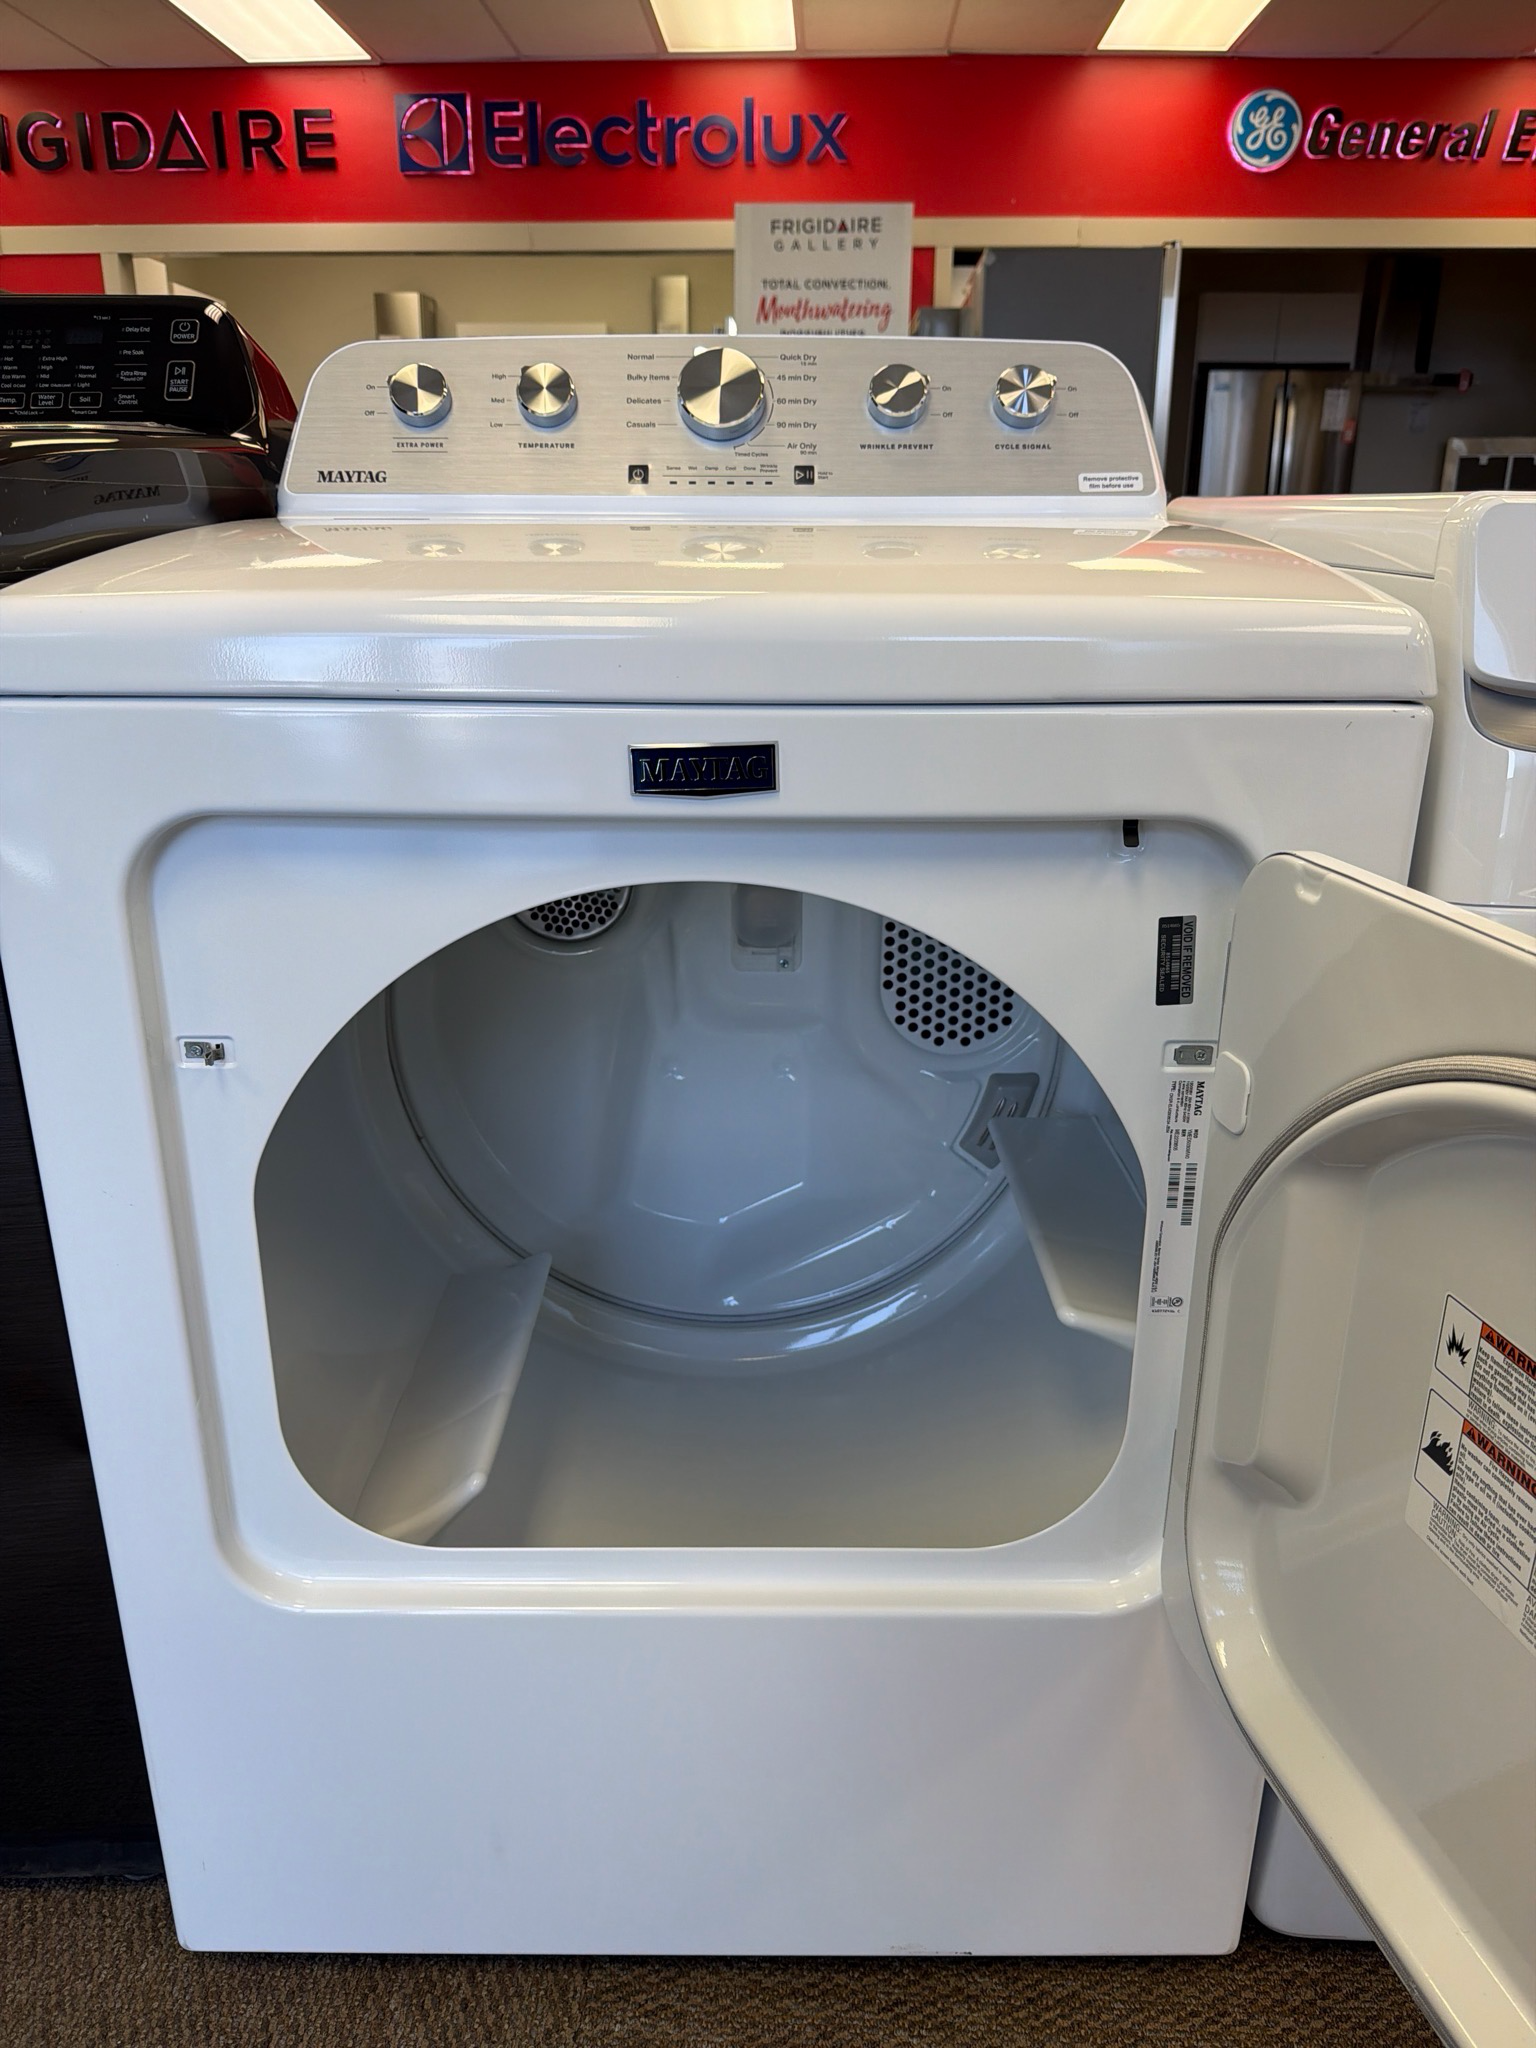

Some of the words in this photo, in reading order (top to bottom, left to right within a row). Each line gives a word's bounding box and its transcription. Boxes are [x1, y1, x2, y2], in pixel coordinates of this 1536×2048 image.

[482, 97, 849, 168] Electrolux
[1305, 105, 1500, 161] General
[770, 216, 883, 235] FRIGIDAIRE
[773, 238, 879, 252] GALLERY
[761, 279, 800, 291] TOTAL
[756, 294, 893, 333] Mouthwatering
[627, 353, 655, 361] Normal
[803, 354, 817, 362] Dry
[492, 373, 507, 381] High
[627, 374, 647, 382] Bulky
[803, 374, 817, 382] Dry
[803, 398, 817, 406] Dry
[803, 422, 817, 430] Dry
[800, 443, 817, 451] Only
[317, 470, 387, 484] MAYTAG
[639, 755, 769, 783] MAYTAG
[1183, 921, 1194, 943] VOID
[1159, 934, 1167, 968] SECURITY
[1182, 945, 1193, 953] IF
[1181, 954, 1193, 998] REMOVED
[1193, 1080, 1206, 1116] MAYTAG
[1497, 1379, 1516, 1400] anything
[1468, 1400, 1497, 1430] WARNING:
[1467, 1448, 1482, 1467] washer
[1491, 1471, 1515, 1498] completely
[1515, 1493, 1533, 1513] remove
[1479, 1476, 1497, 1499] anything
[1498, 1468, 1514, 1487] Hazard
[1432, 1500, 1461, 1534] WARNING:
[1454, 1478, 1465, 1492] Items
[1465, 1489, 1487, 1515] containing
[1488, 1509, 1500, 1526] foam,
[1501, 1522, 1518, 1543] rubber,
[1462, 1501, 1473, 1518] using
[1487, 1525, 1500, 1544] Cycle.
[1495, 1500, 1518, 1527] (including
[1431, 1509, 1457, 1538] CAUTION:
[1450, 1497, 1464, 1516] Failure
[1470, 1516, 1483, 1534] follow
[1483, 1529, 1495, 1546] these
[1495, 1542, 1521, 1571] instructions
[1452, 1484, 1466, 1502] plastic
[1466, 1498, 1477, 1512] must
[1483, 1514, 1495, 1529] dried
[1505, 1535, 1530, 1563] clothesline
[1456, 1512, 1468, 1528] result
[1473, 1529, 1486, 1545] death
